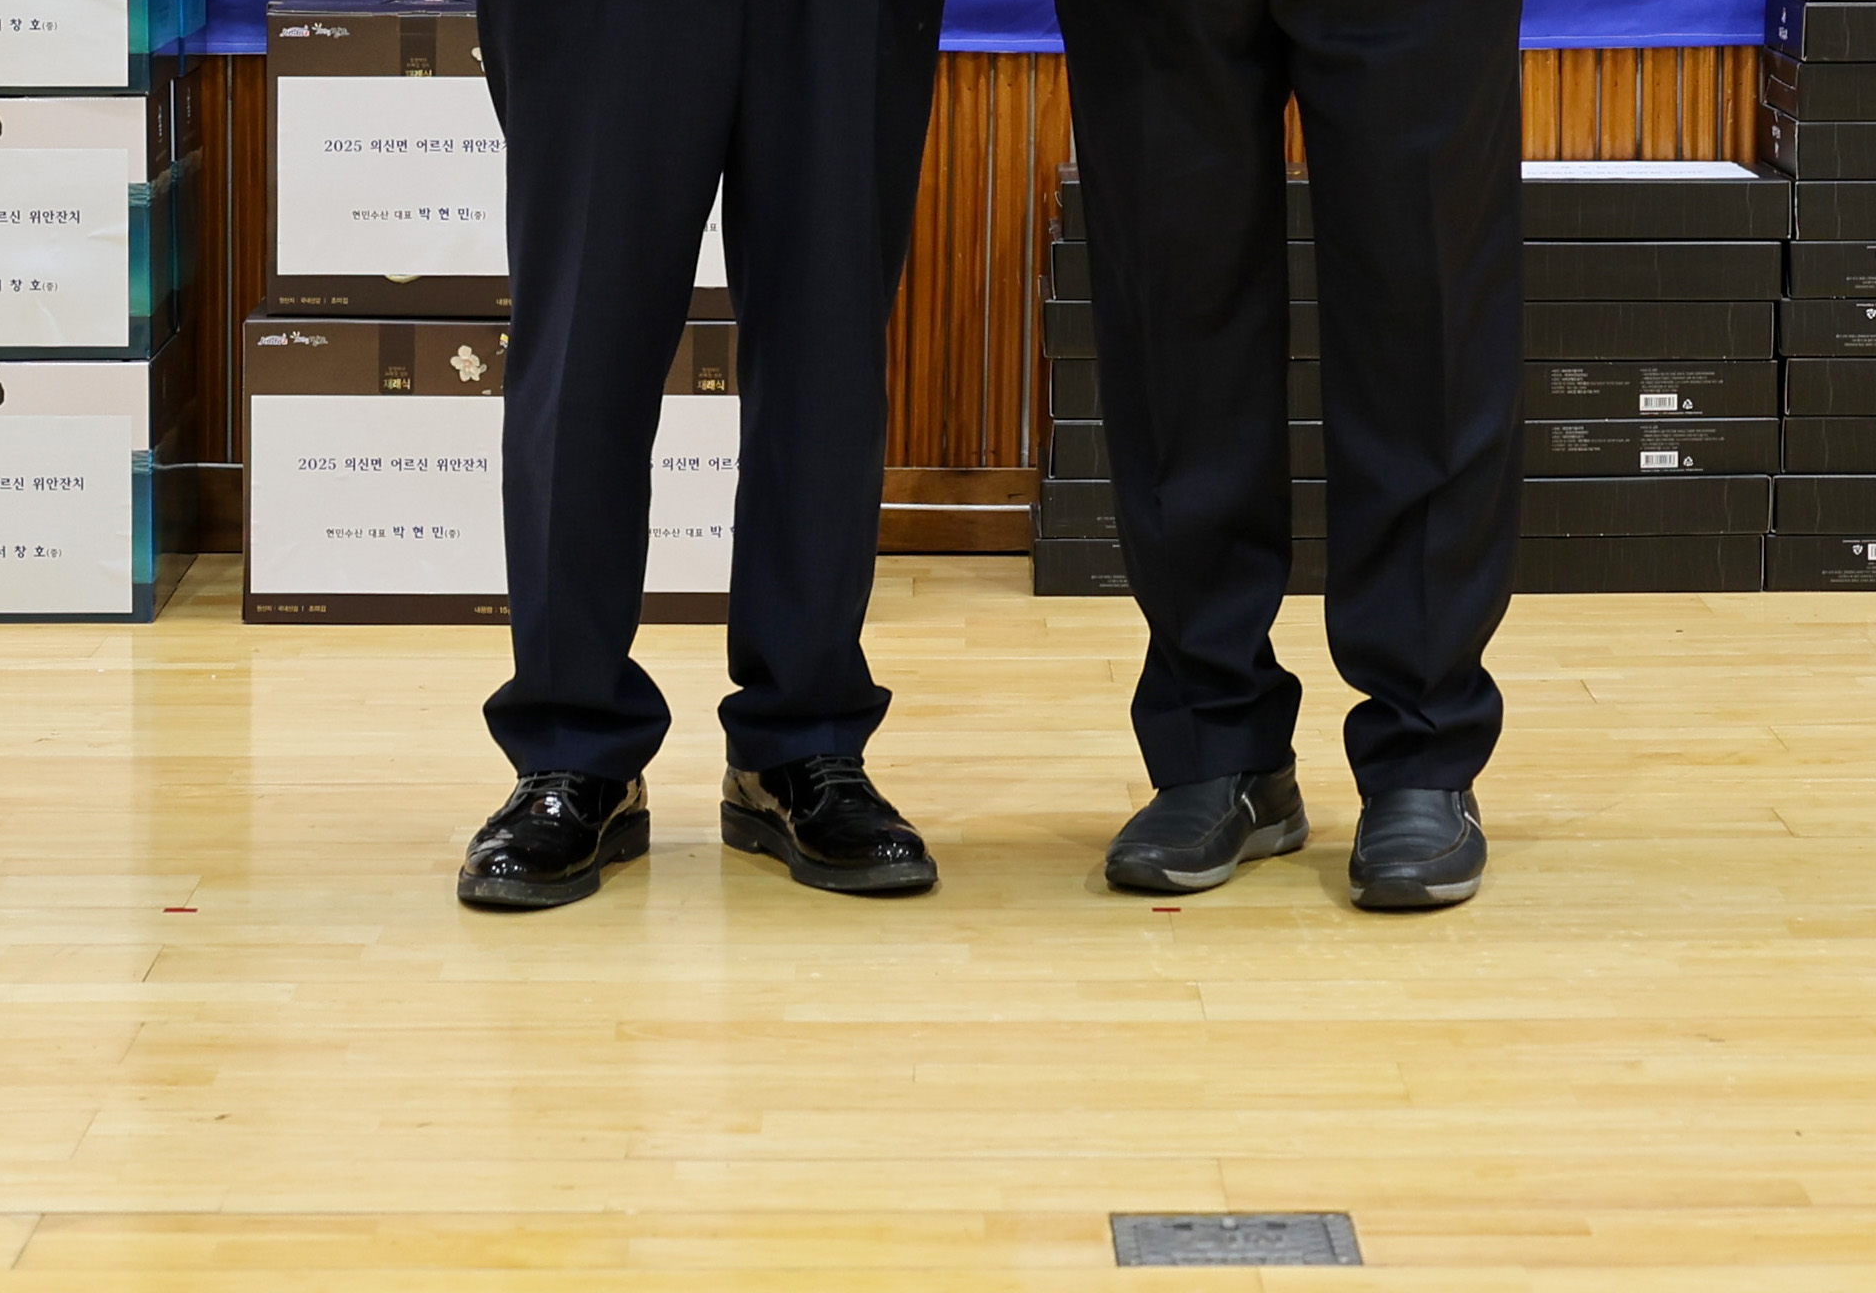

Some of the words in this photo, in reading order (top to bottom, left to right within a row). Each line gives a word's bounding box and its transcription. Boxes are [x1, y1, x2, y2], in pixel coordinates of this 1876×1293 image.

[323, 139, 363, 153] 2025
[369, 138, 408, 154] 의신면
[415, 138, 454, 154] 어르신
[28, 209, 81, 225] 위안잔치
[351, 209, 390, 221] 현민수산
[297, 457, 337, 471] 2025
[344, 456, 383, 472] 의신면
[390, 457, 429, 473] 어르신
[436, 457, 488, 473] 위안잔치
[661, 456, 701, 472] 의신면
[32, 476, 85, 492] 위안잔치
